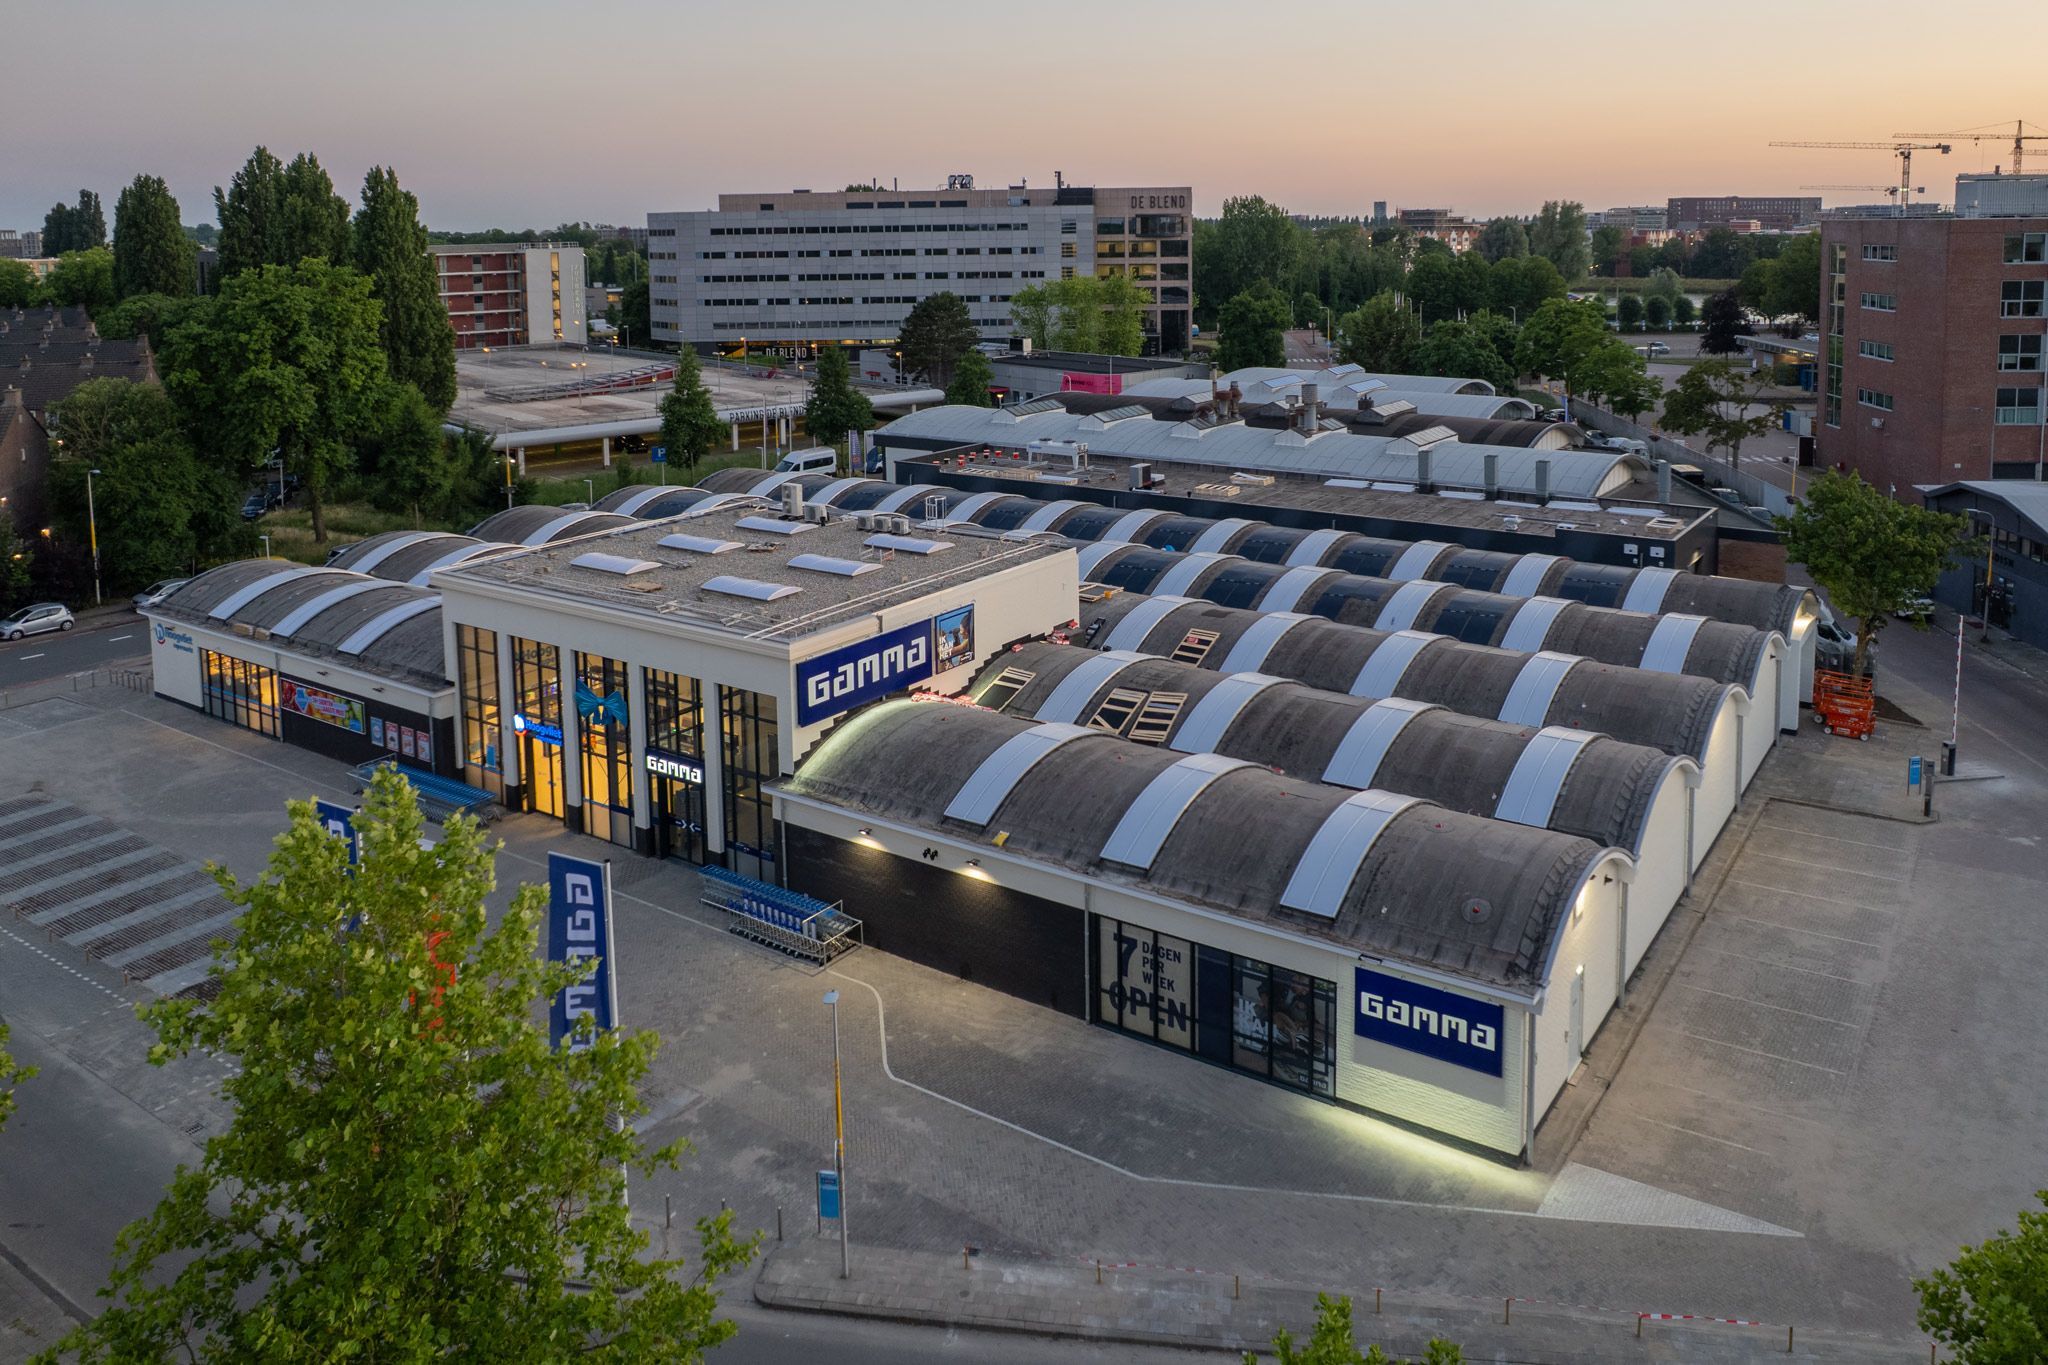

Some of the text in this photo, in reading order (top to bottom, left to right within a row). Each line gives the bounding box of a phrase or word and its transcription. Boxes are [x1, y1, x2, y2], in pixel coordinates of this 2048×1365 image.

[1131, 195, 1185, 208] DE BLEND
[729, 409, 764, 423] PARKING
[1113, 932, 1138, 977] 7
[1142, 971, 1176, 993] WEK
[1109, 981, 1187, 1033] OPEN
